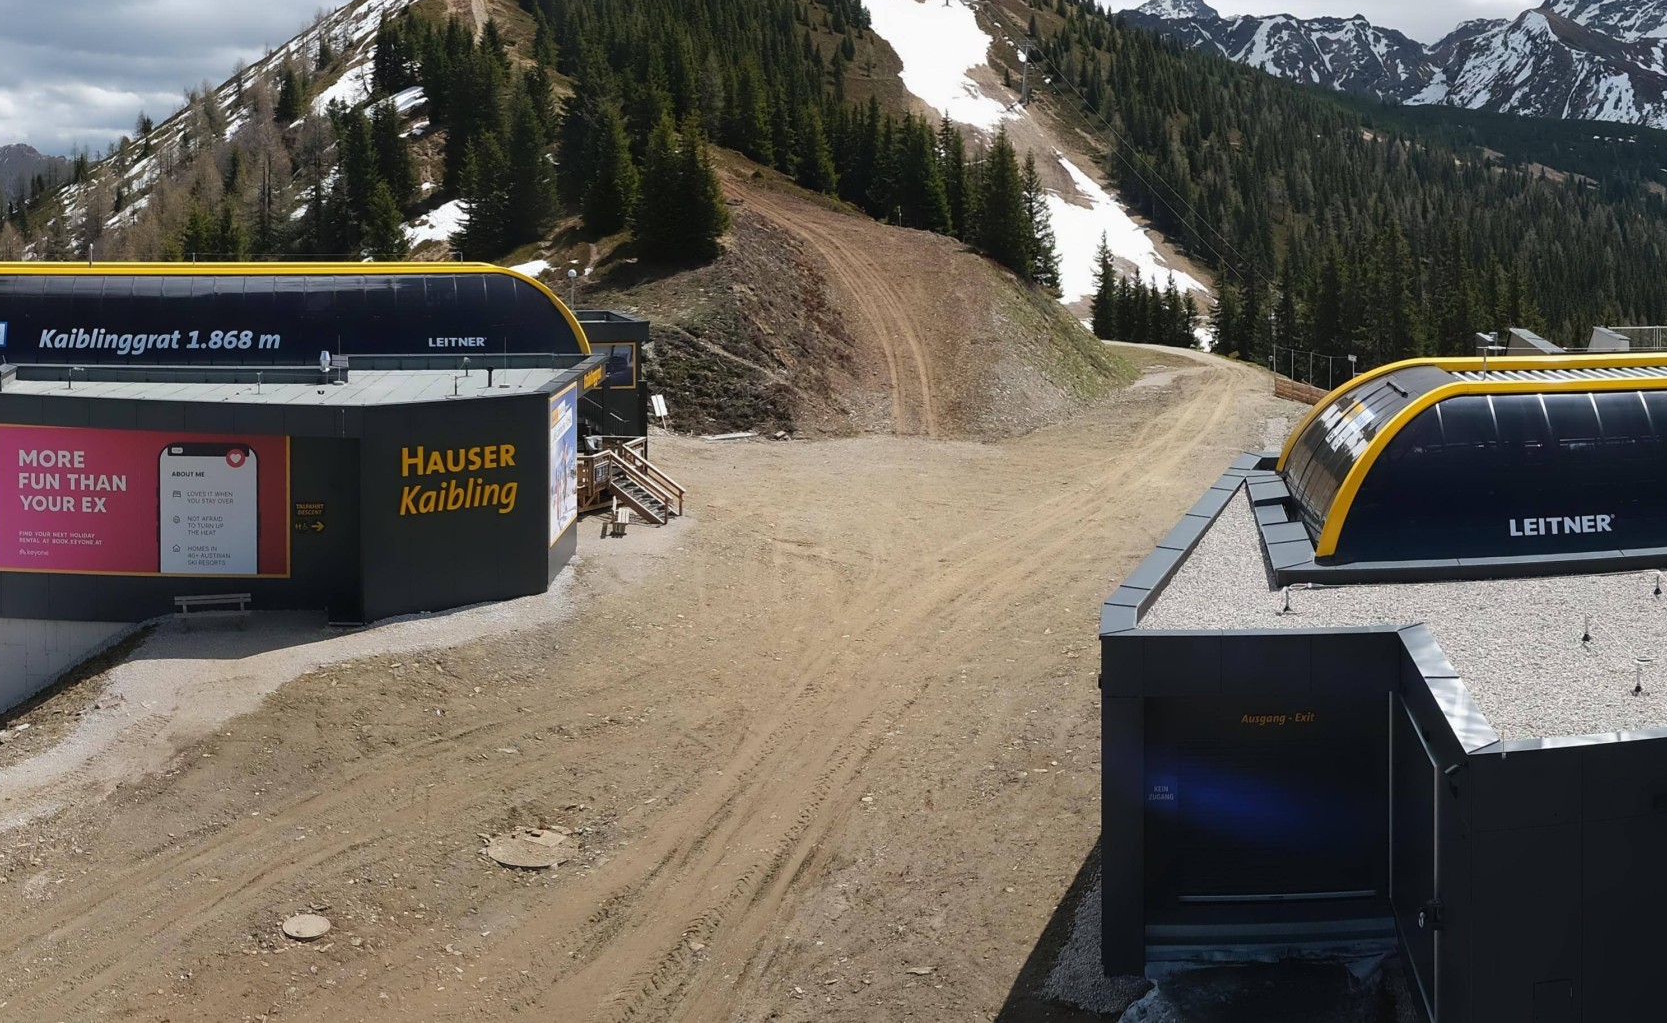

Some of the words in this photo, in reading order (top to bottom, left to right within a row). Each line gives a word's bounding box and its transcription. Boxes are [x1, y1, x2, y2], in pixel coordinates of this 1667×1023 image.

[38, 328, 181, 356] Kaiblinggrat
[185, 330, 254, 350] 1.868
[258, 333, 281, 349] m
[428, 337, 486, 348] LEITNER
[18, 449, 85, 468] MORE
[401, 444, 516, 477] HAUSER
[18, 472, 60, 490] FUN
[67, 473, 127, 492] THAN
[19, 495, 76, 512] YOUR
[81, 496, 107, 513] EX
[399, 477, 518, 516] Kaibling
[1509, 514, 1613, 536] LEITNER
[1240, 713, 1286, 726] Ausgang
[1295, 712, 1316, 723] Exit
